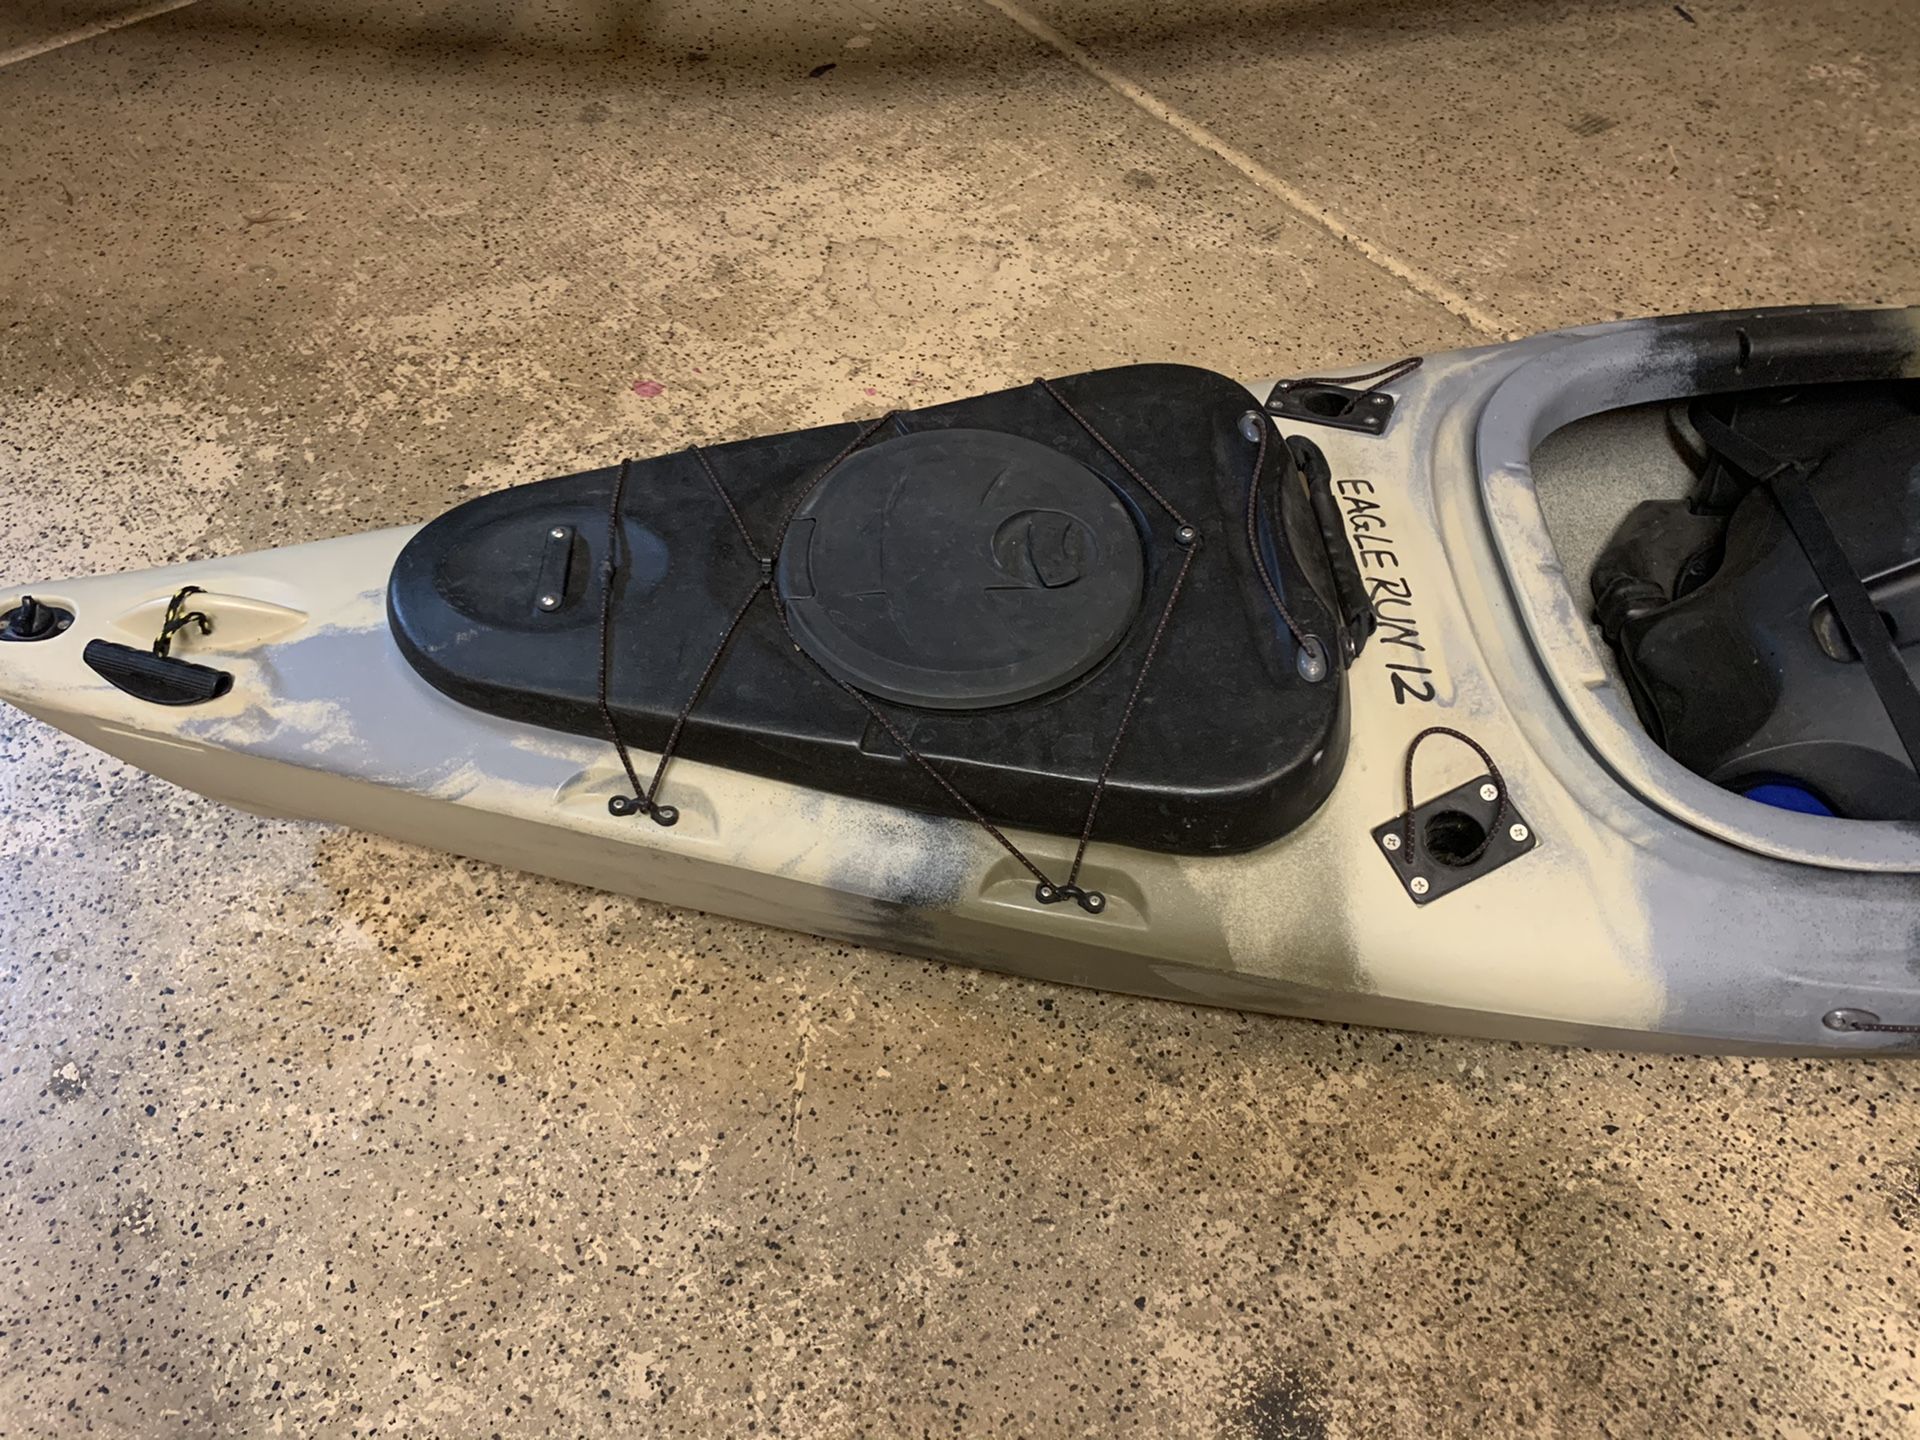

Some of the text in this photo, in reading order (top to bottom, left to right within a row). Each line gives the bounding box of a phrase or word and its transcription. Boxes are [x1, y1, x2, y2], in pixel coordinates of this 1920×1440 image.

[1337, 479, 1435, 704] EAGLE RUN 12
